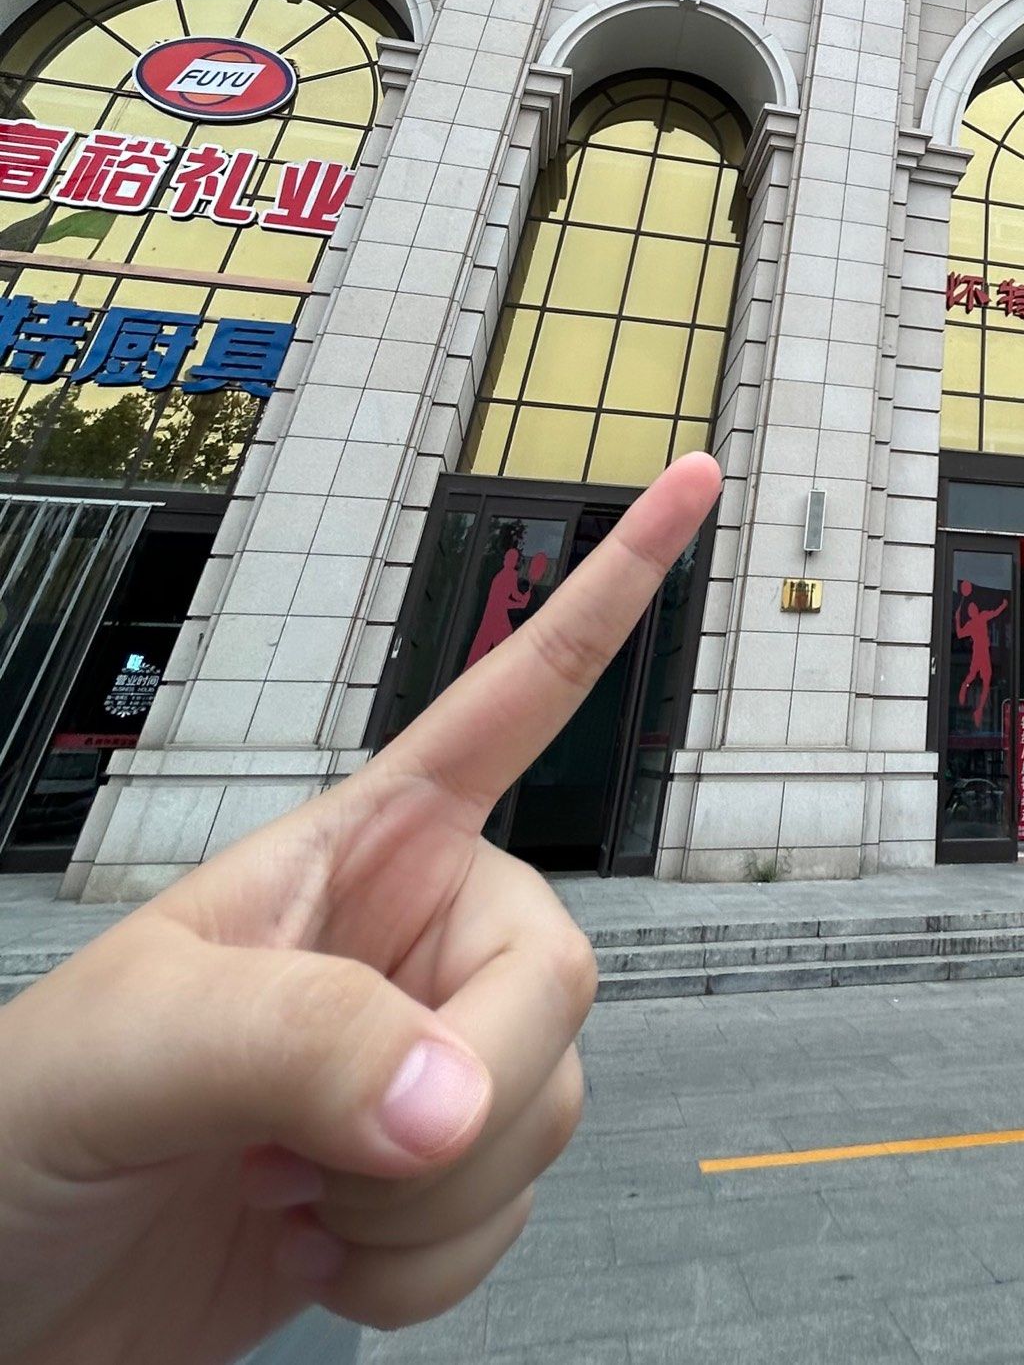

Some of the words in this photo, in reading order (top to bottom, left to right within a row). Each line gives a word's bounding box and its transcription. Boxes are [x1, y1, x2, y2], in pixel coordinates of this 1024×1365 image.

[176, 68, 256, 89] FUYU
[115, 675, 160, 686] 营业时间
